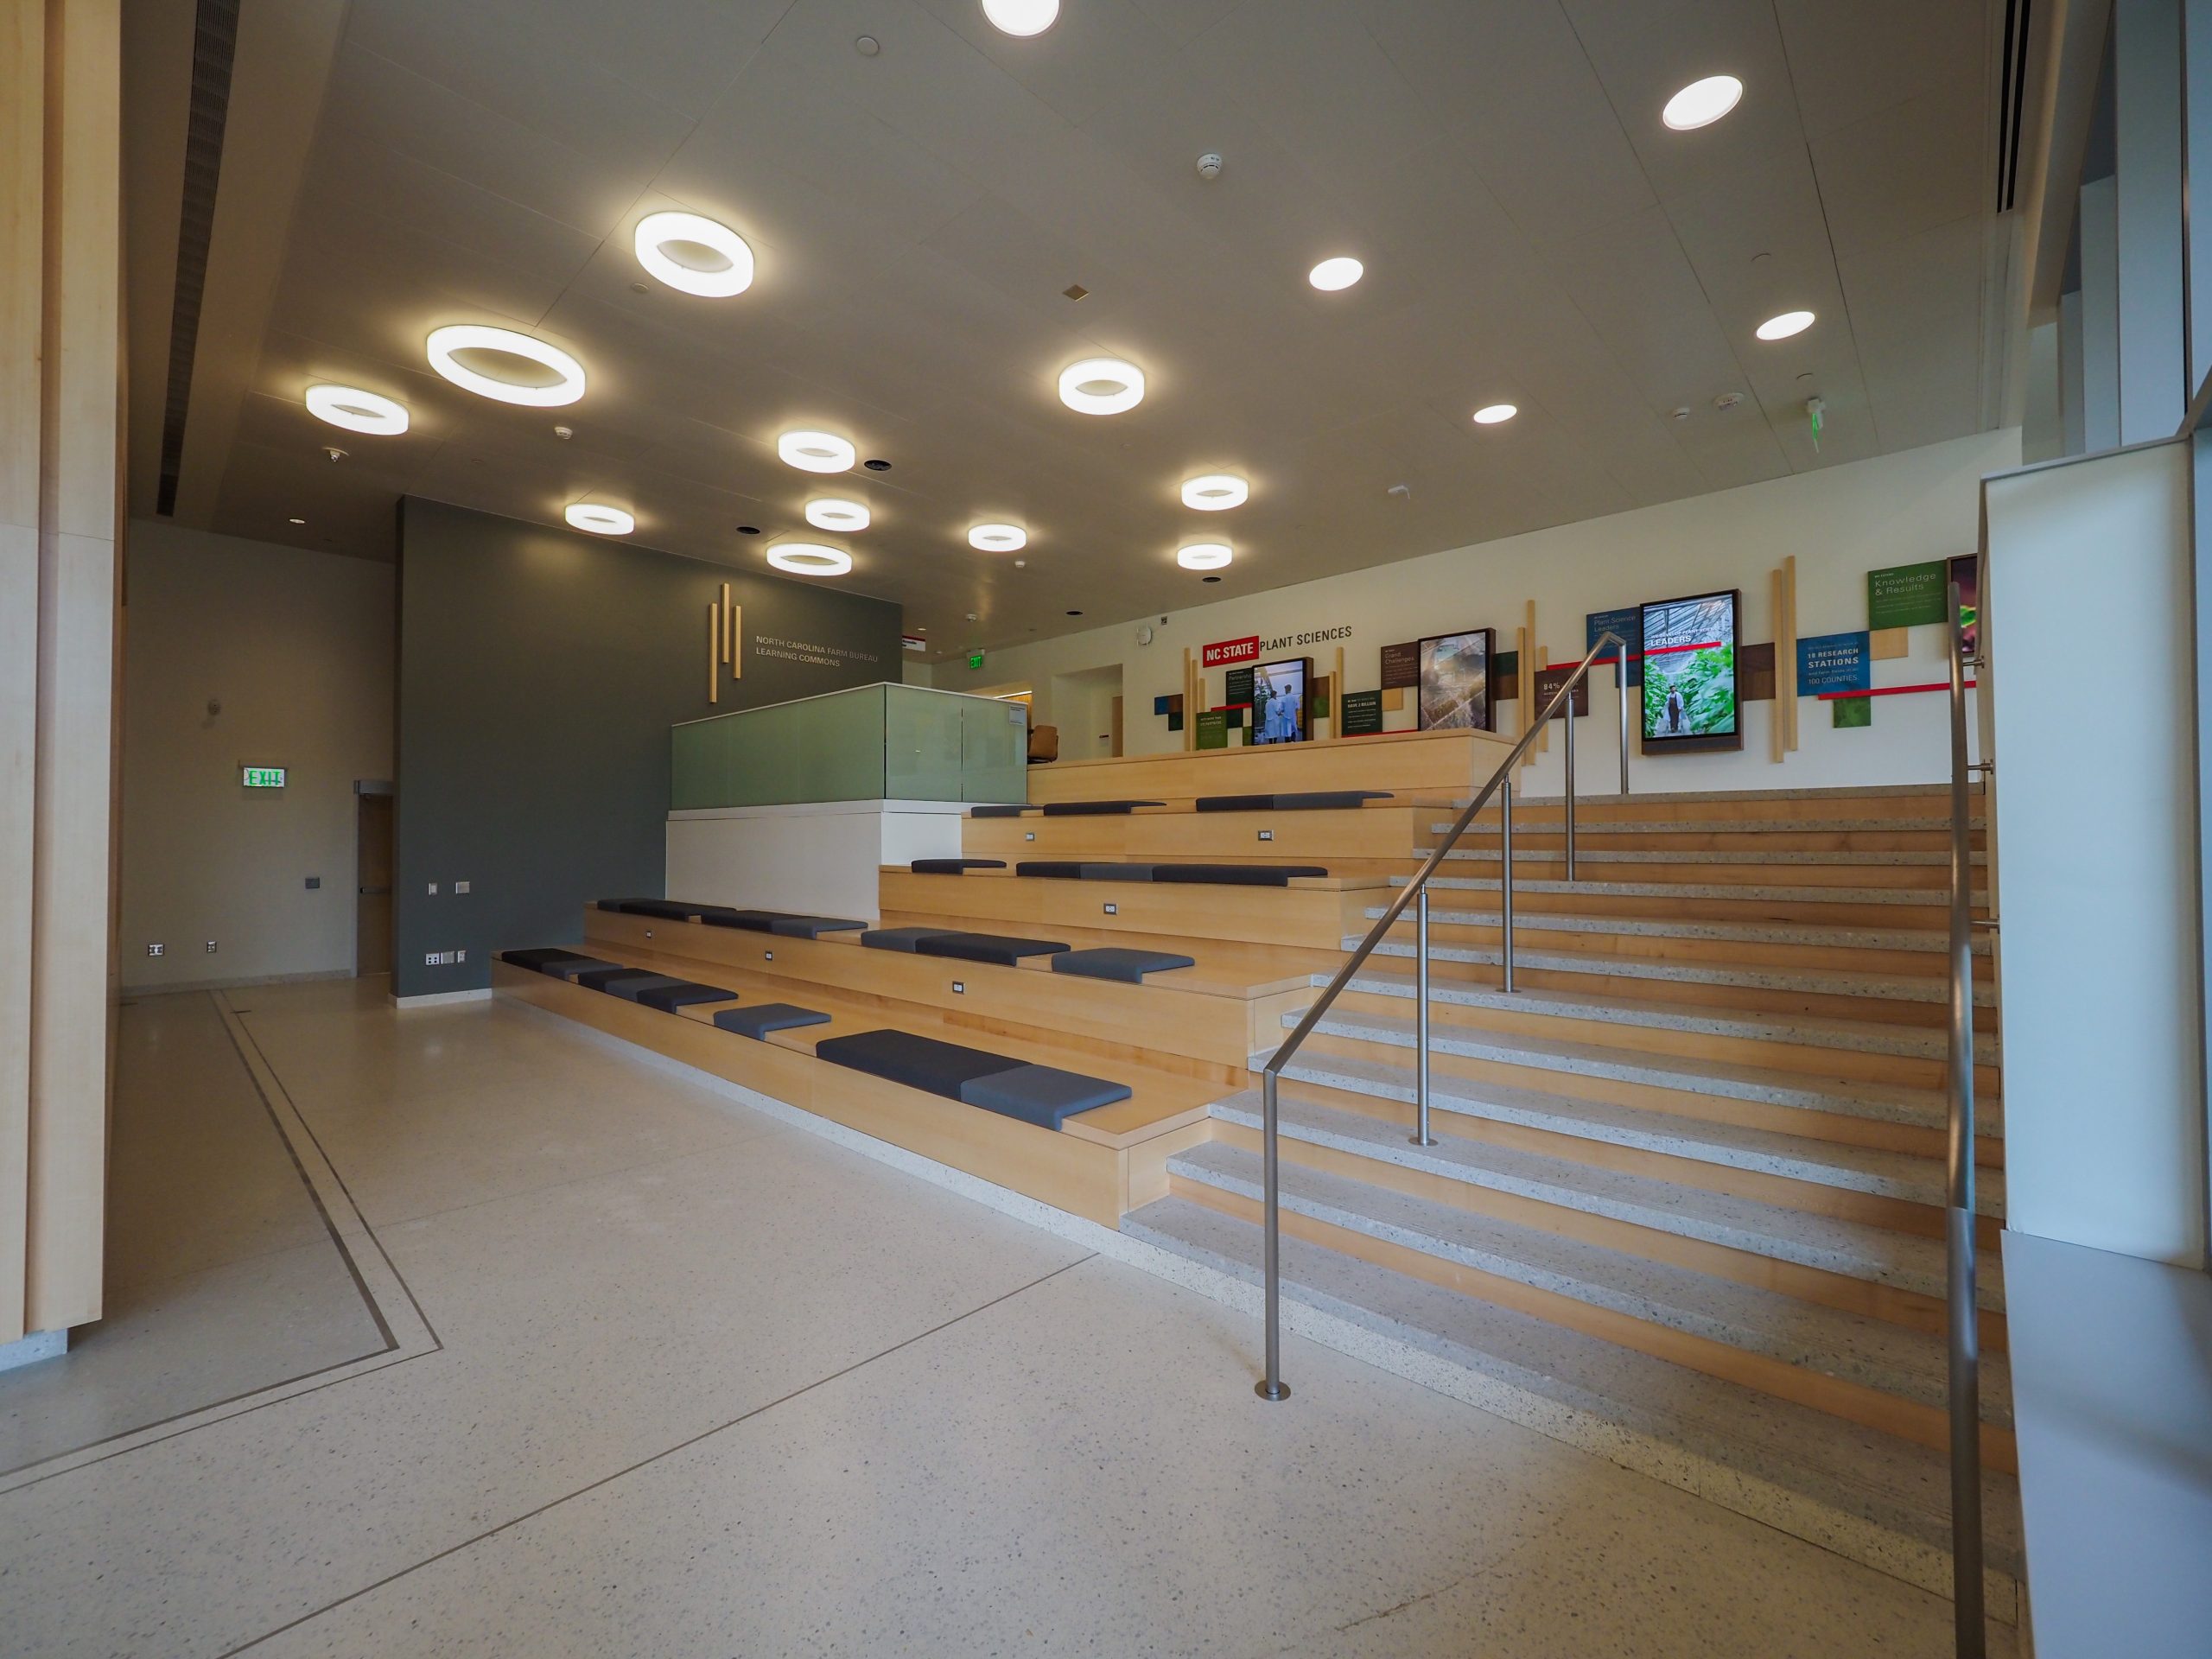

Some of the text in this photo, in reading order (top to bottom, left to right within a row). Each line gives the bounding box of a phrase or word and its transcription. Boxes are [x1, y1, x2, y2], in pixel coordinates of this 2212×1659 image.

[1874, 573, 1936, 588] Knowledge
[1886, 583, 1924, 594] Results
[1593, 624, 1620, 632] Leaders
[1206, 626, 1353, 662] NC STATE PLANT SCIENCES
[1650, 635, 1692, 646] LEADERS
[756, 635, 878, 663] NORTH CAROLINA FARM BUREAU
[1818, 648, 1859, 658] RESEARCH
[756, 647, 841, 667] LEARNING COMMONS
[969, 656, 982, 668] EXIT
[1808, 657, 1859, 669] STATIONS
[249, 770, 281, 785] EXIT
